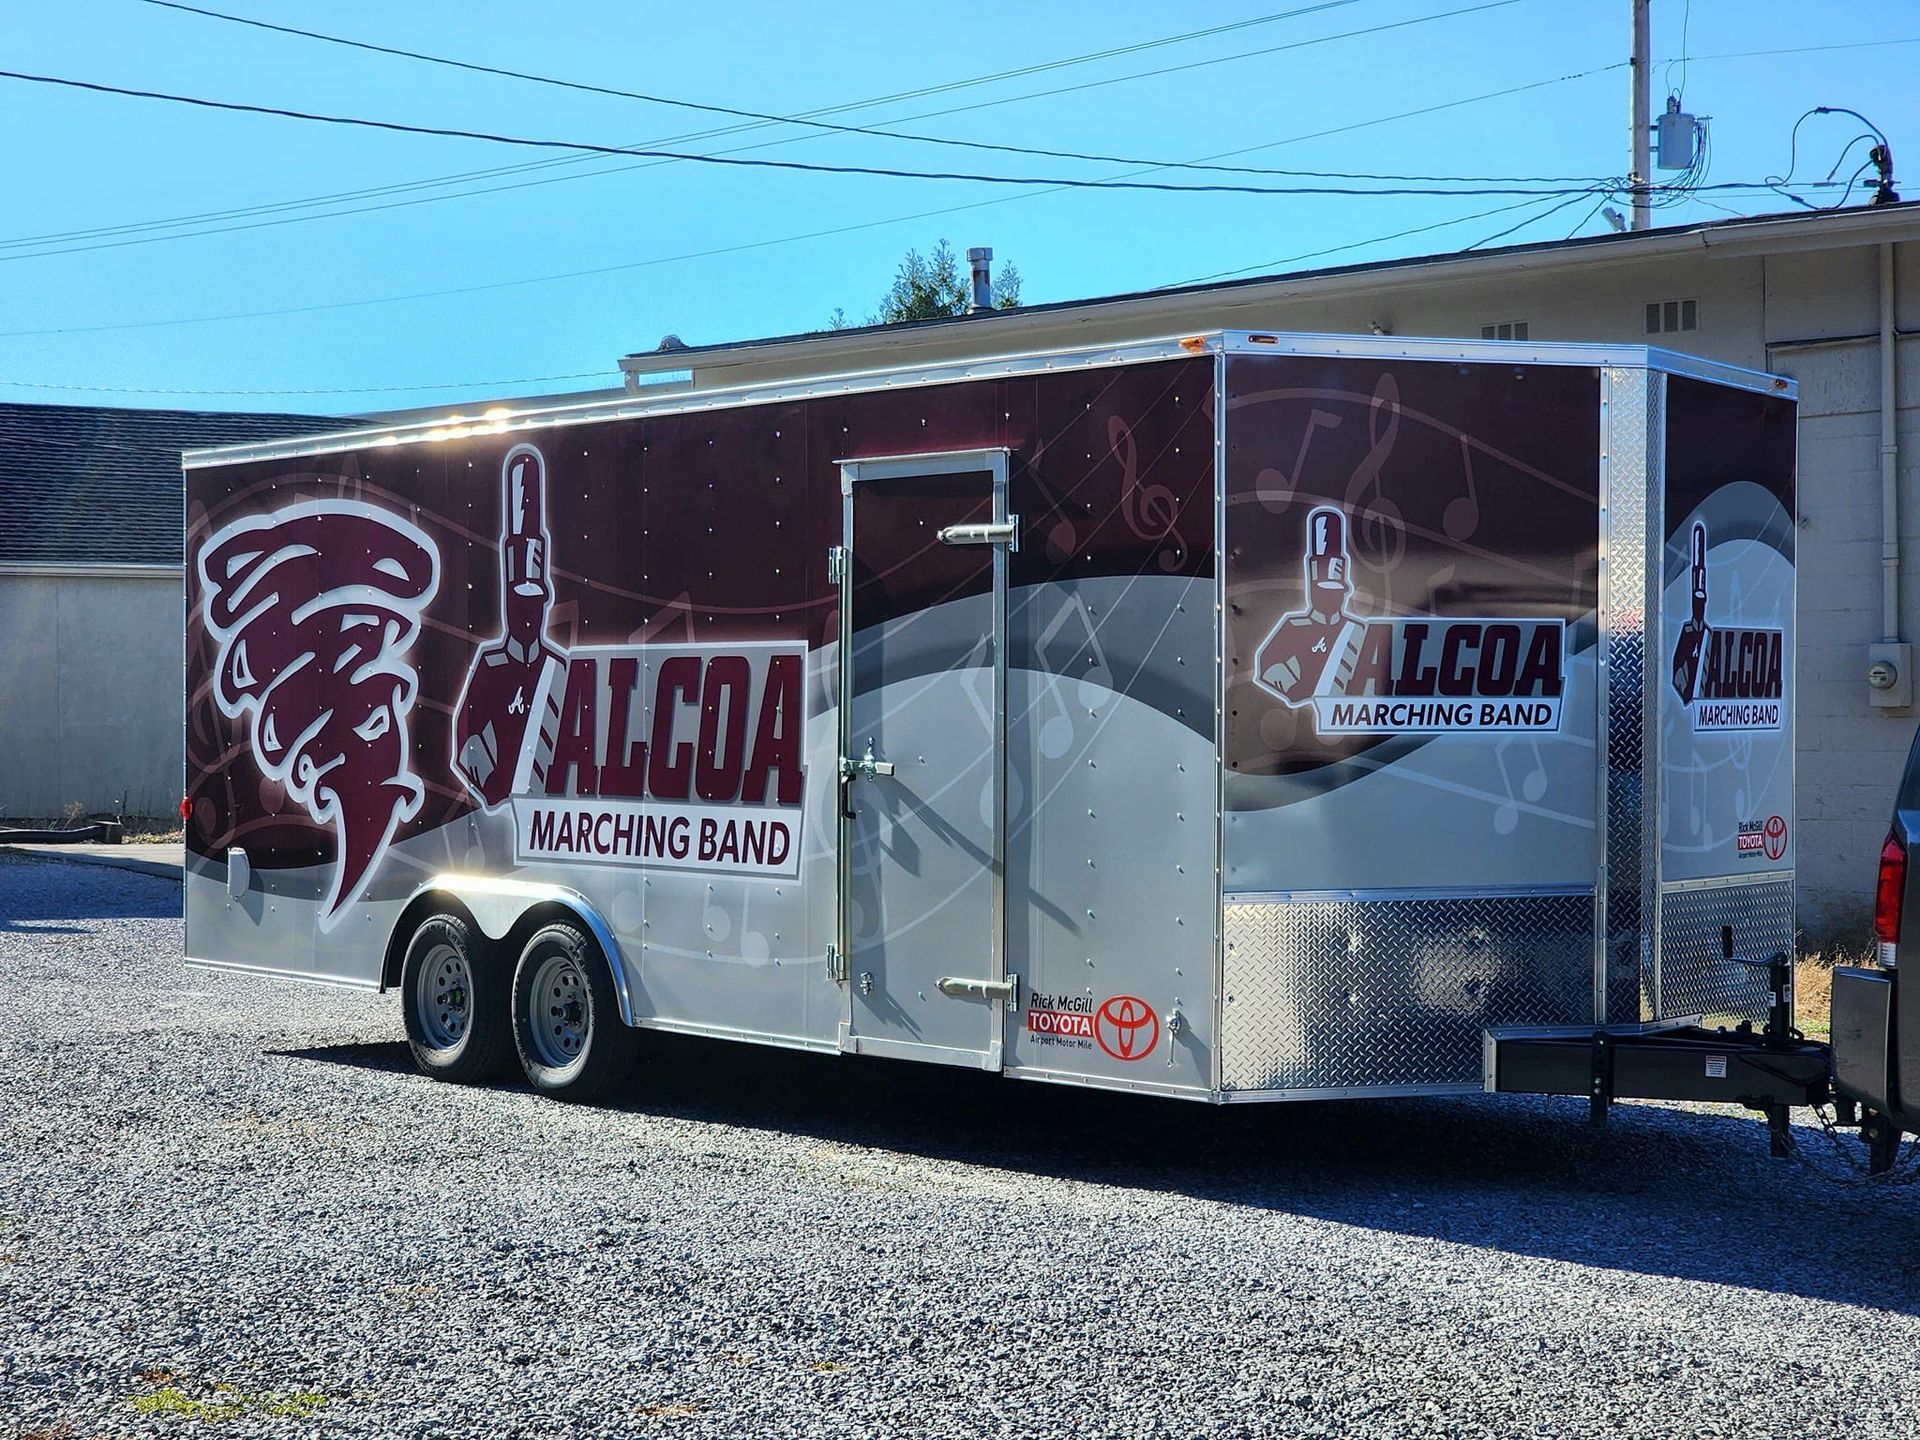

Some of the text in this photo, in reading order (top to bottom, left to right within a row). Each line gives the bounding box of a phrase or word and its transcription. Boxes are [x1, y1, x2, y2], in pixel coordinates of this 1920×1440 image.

[1344, 624, 1561, 696] ALCOA
[1704, 631, 1782, 698] ALCOA
[1331, 704, 1552, 726] MARCHING BAND
[1698, 704, 1779, 726] MARCHING BAND
[545, 655, 803, 803] ALCOA
[529, 811, 791, 866] MARCHING BAND
[1738, 835, 1762, 848] TOYOTA
[1030, 993, 1093, 1013] Rick McGill
[1030, 1012, 1092, 1035] TOYOTA
[1030, 1035, 1093, 1050] Airport Motor Mile
